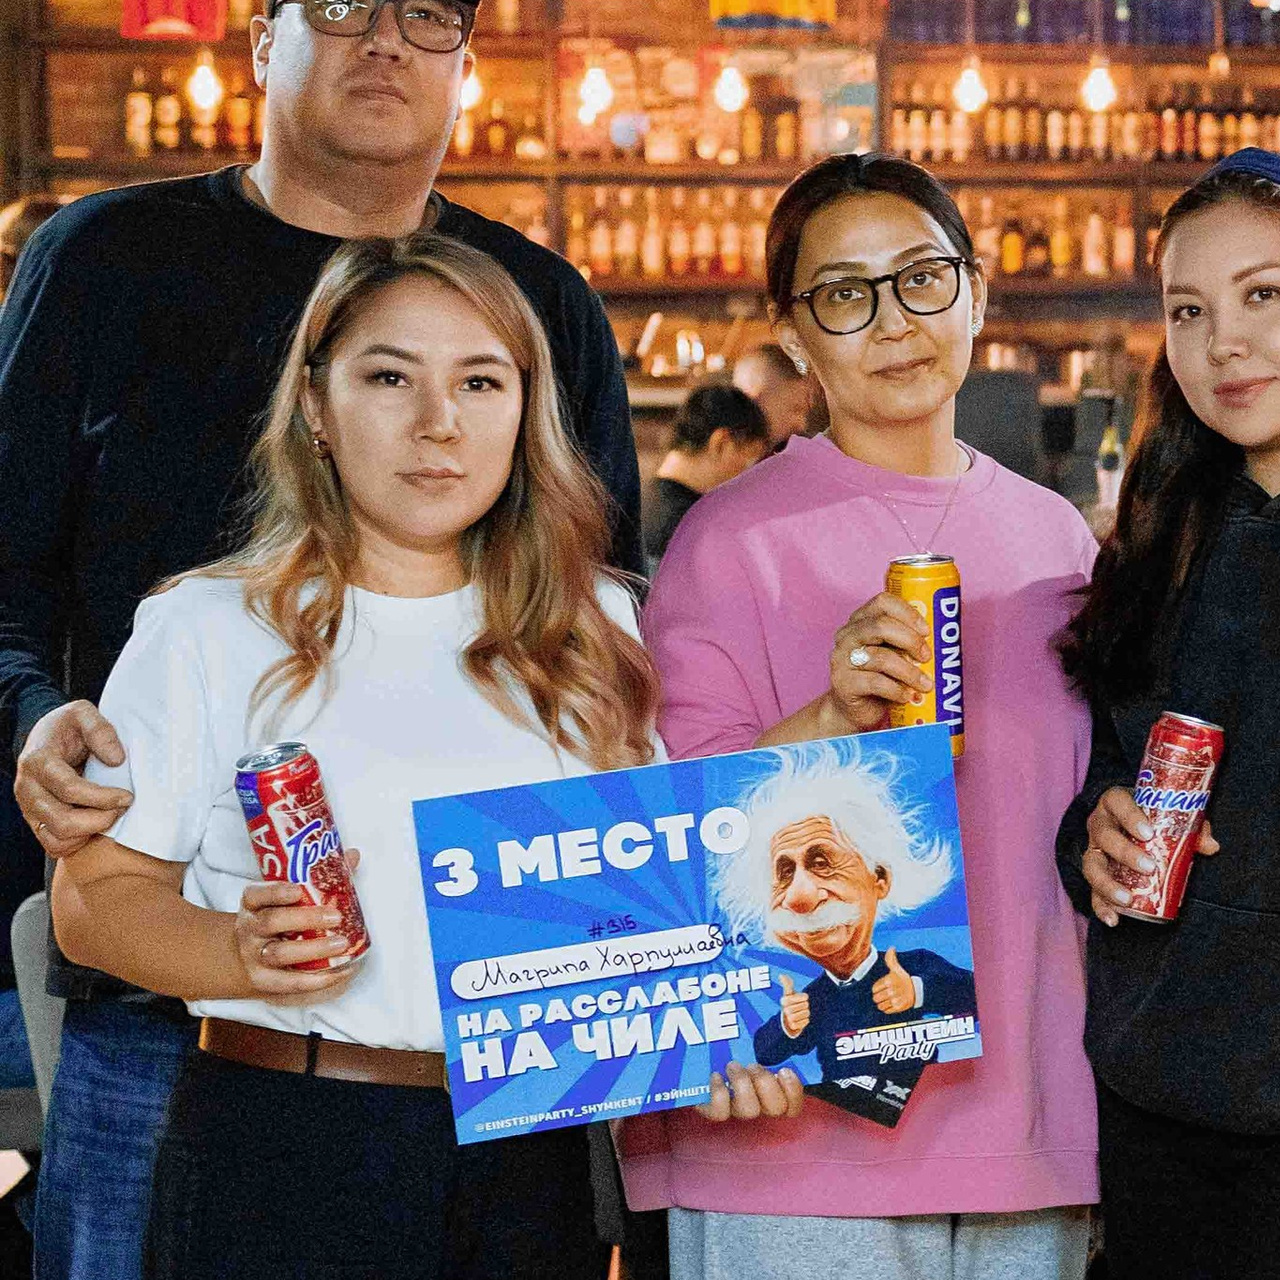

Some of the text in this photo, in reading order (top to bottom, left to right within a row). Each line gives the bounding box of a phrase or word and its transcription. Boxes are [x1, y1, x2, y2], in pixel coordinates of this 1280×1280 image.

[940, 596, 963, 726] DONAVI
[432, 806, 751, 898] 3 МЕСТО
[457, 965, 772, 1039] НА РАССЛАБОНЕ
[460, 998, 740, 1084] НА ЧИЛЕ
[879, 1041, 938, 1065] Party
